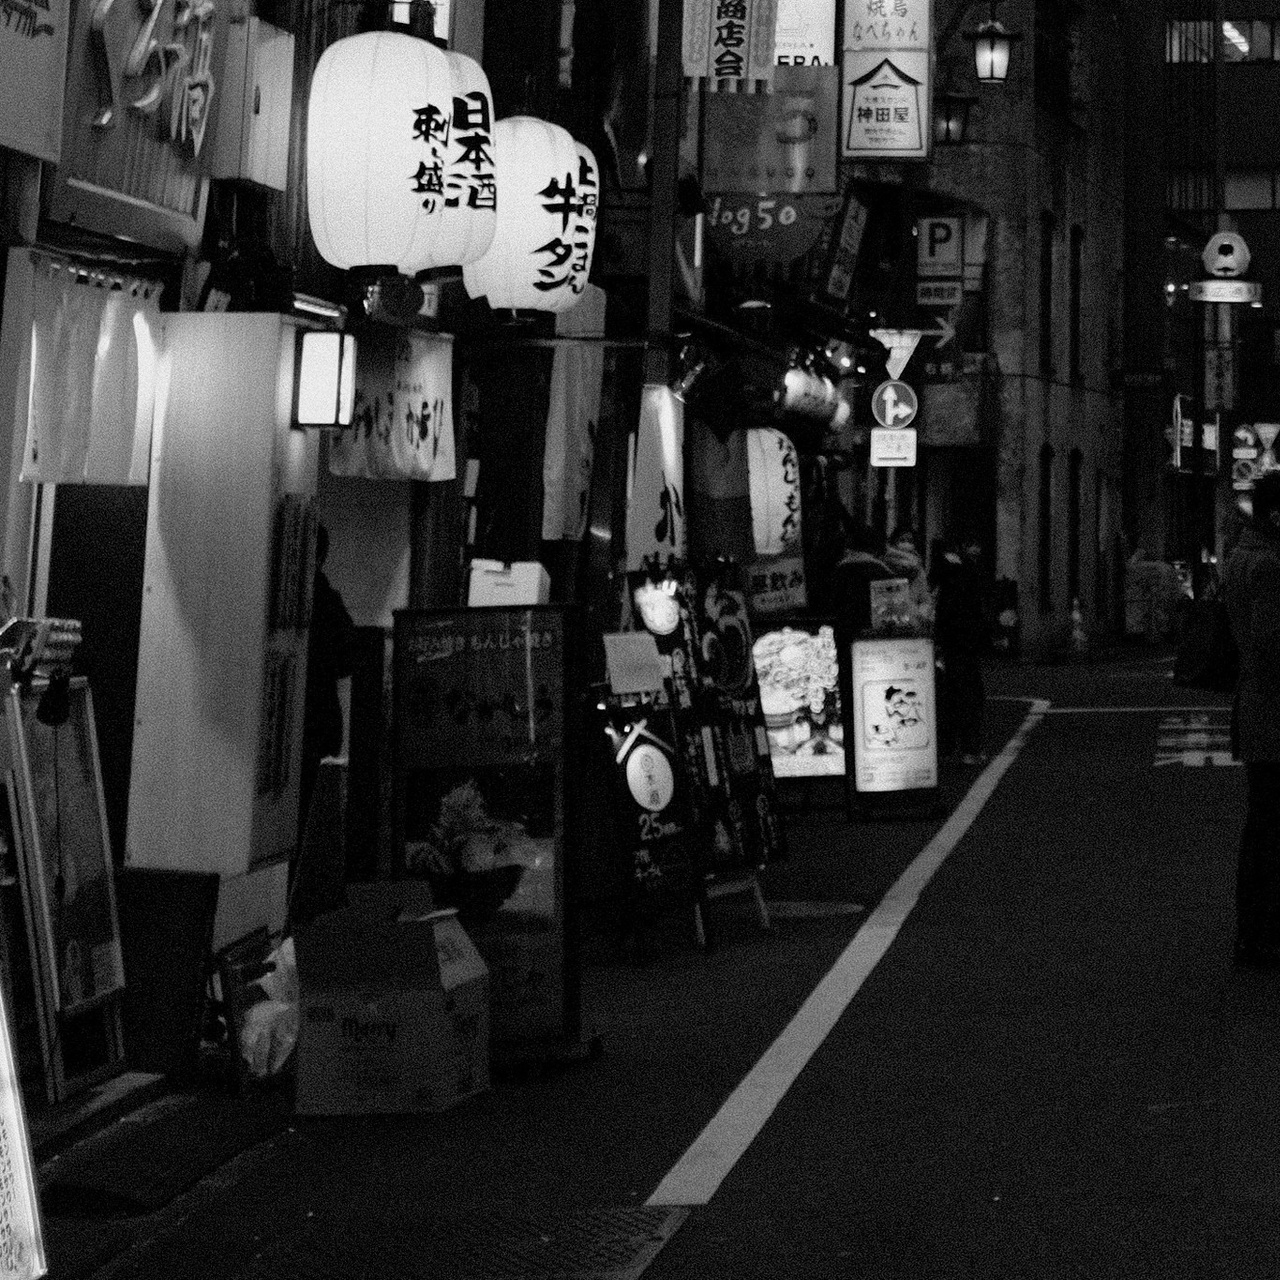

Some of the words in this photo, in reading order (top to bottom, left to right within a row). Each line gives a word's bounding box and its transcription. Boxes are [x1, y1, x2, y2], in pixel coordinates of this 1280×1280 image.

[407, 102, 452, 216] 刺し盛り
[443, 90, 497, 212] 日本酒
[857, 105, 910, 124] 神田屋
[530, 170, 578, 292] 牛タン
[926, 222, 948, 258] P
